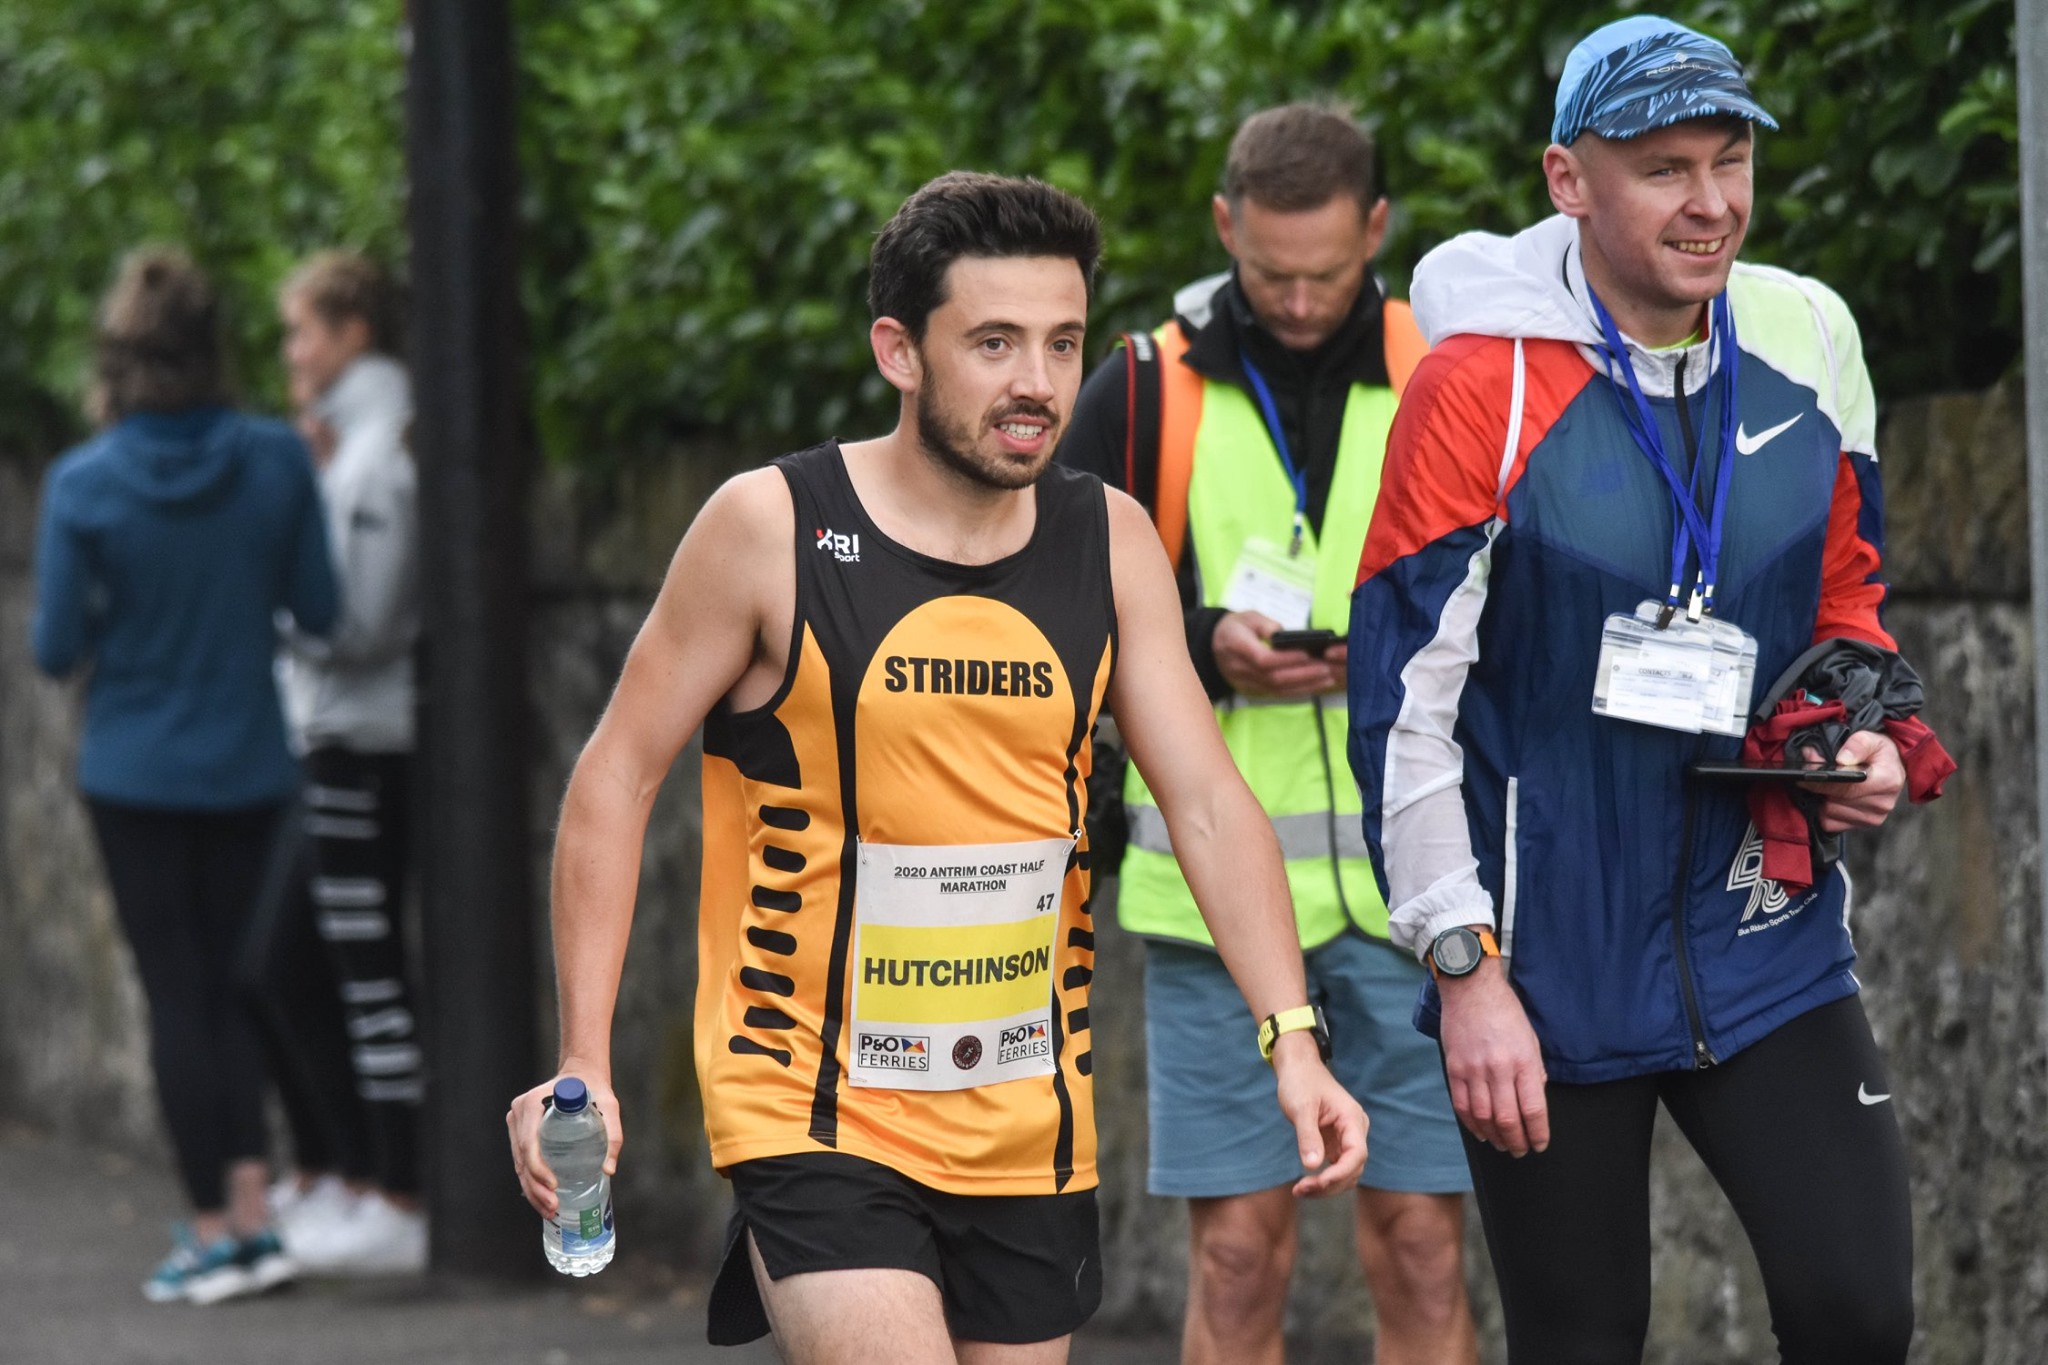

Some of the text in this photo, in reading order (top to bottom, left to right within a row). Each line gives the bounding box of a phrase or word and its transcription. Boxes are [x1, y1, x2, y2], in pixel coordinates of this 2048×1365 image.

[884, 655, 1054, 699] STRIDERS
[894, 859, 1045, 878] 2020 ANTRIM COAST HALF
[940, 879, 1007, 893] MARATHON
[1036, 893, 1055, 912] 47
[1750, 922, 1770, 933] Ribbon
[1768, 913, 1790, 927] Sports
[863, 945, 1050, 987] HUTCHINSON
[861, 1035, 900, 1052] P&O
[1001, 1027, 1027, 1047] P&O
[999, 1040, 1047, 1062] FERRIES
[860, 1053, 927, 1069] FERRIES
